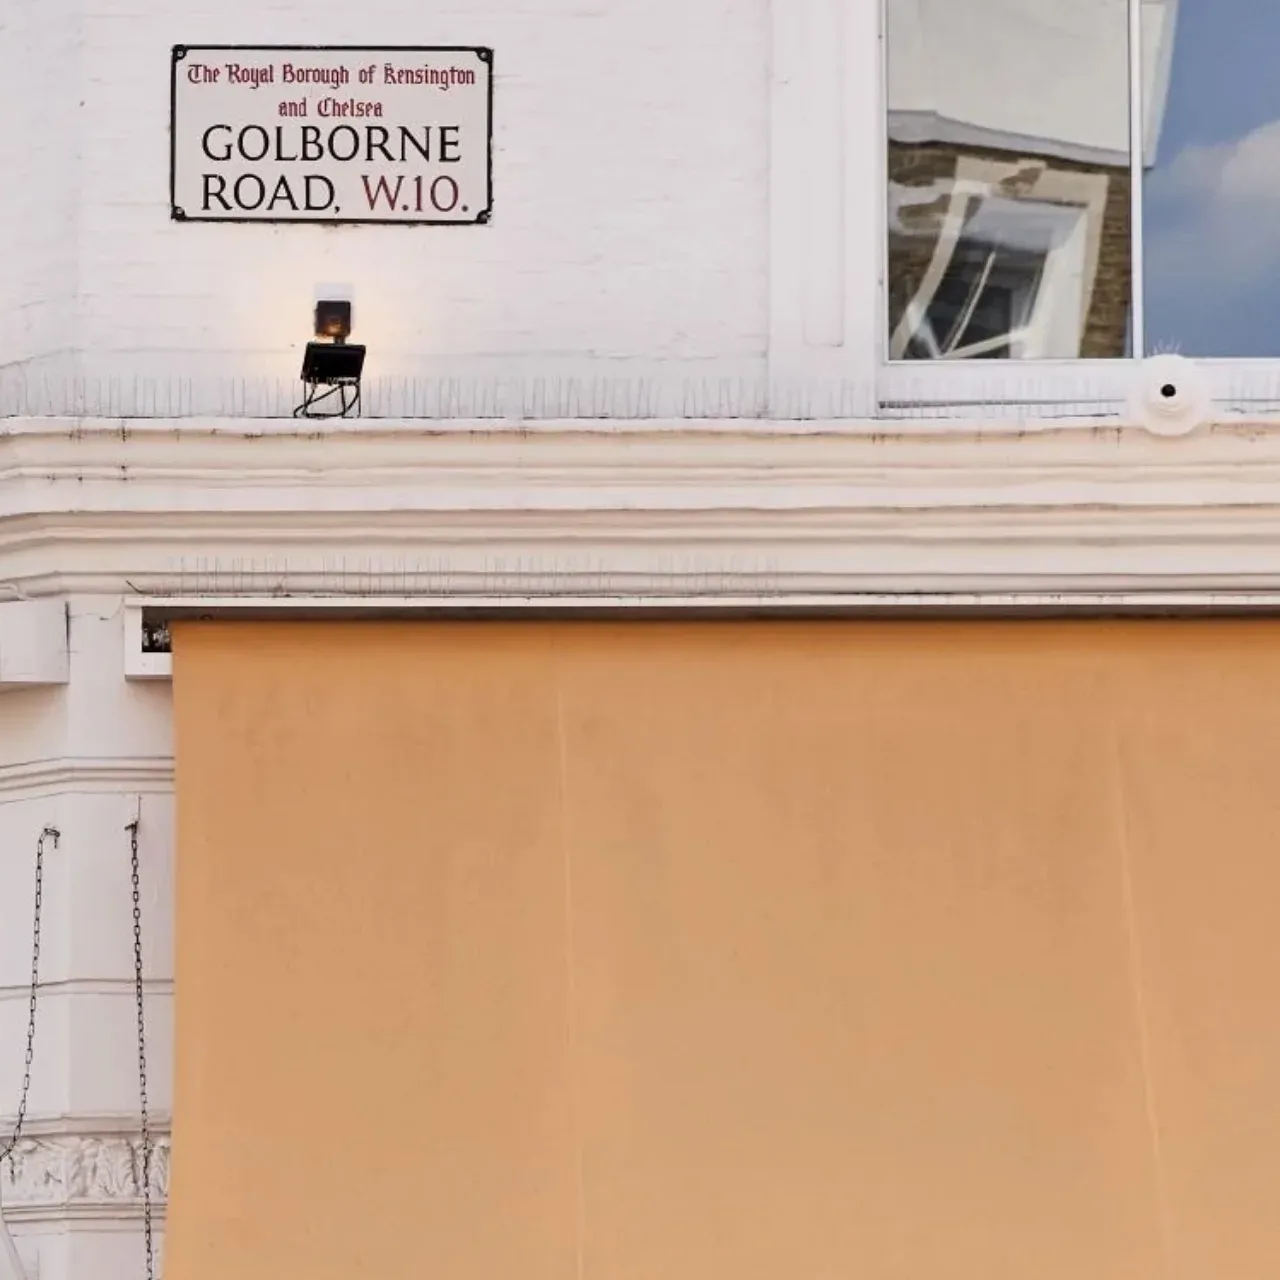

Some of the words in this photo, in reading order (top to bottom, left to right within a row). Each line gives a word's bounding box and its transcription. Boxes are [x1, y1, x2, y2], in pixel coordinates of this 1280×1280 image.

[188, 64, 220, 84] The
[225, 64, 274, 89] Royal
[283, 64, 349, 89] Borough
[358, 64, 377, 84] of
[384, 62, 476, 90] Kensington
[278, 97, 307, 117] and
[318, 97, 383, 117] Chelsea
[201, 124, 462, 162] GOLBORNE
[201, 174, 341, 214] ROAD,
